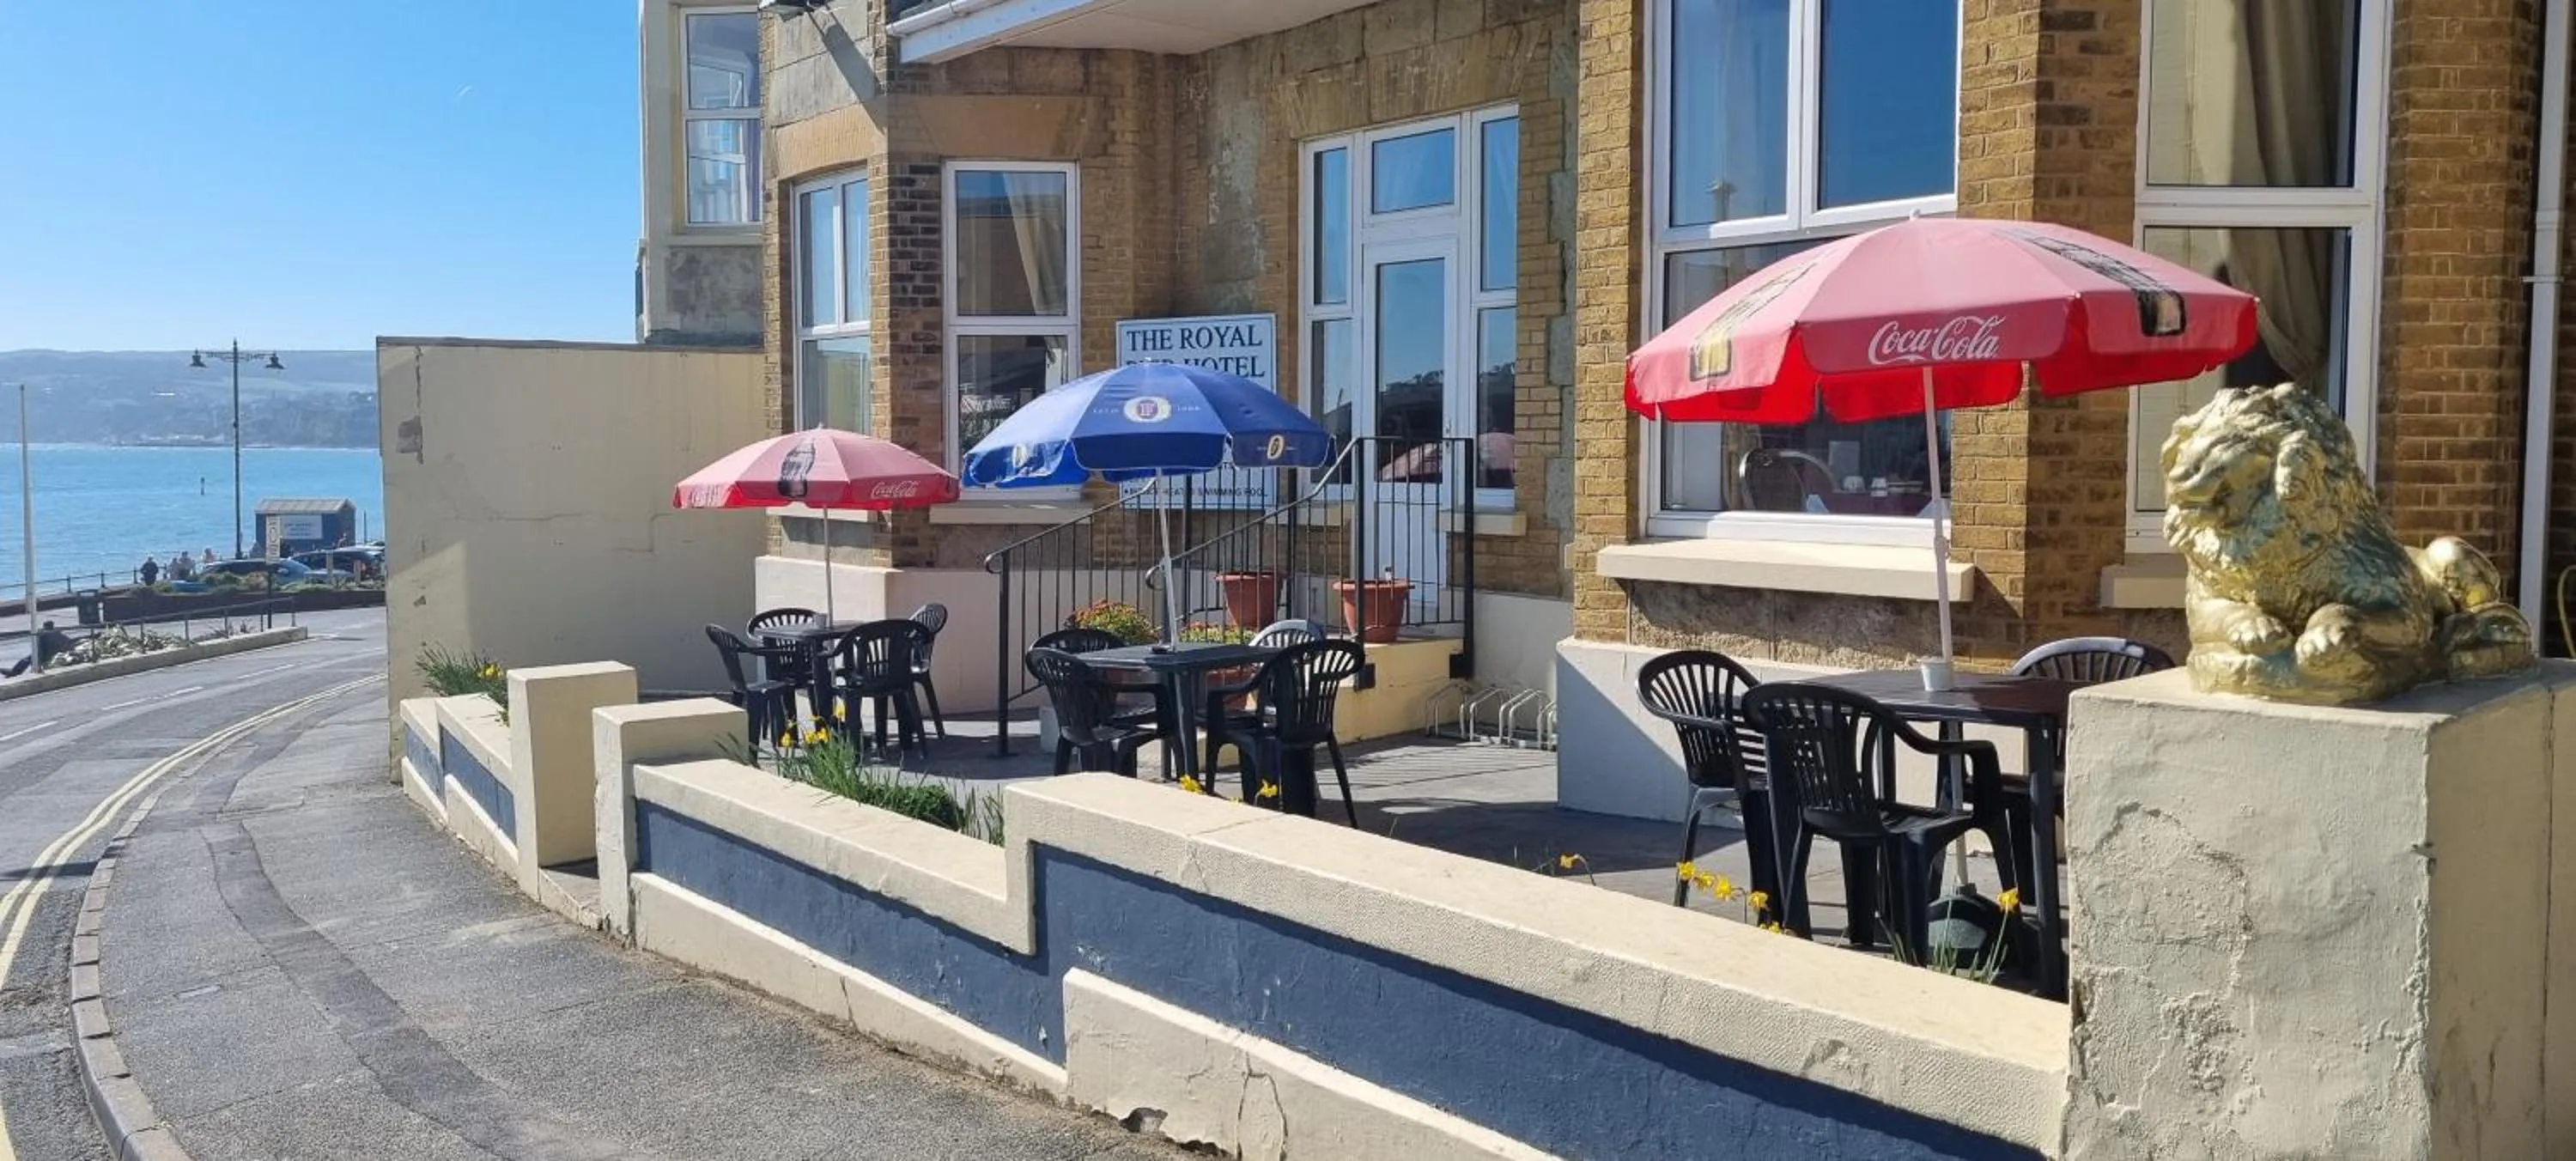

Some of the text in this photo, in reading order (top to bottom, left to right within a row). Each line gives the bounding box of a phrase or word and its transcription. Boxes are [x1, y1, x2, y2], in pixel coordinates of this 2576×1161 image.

[1126, 325, 1262, 351] THE ROYAL
[1868, 314, 2007, 365] Coca-Cola
